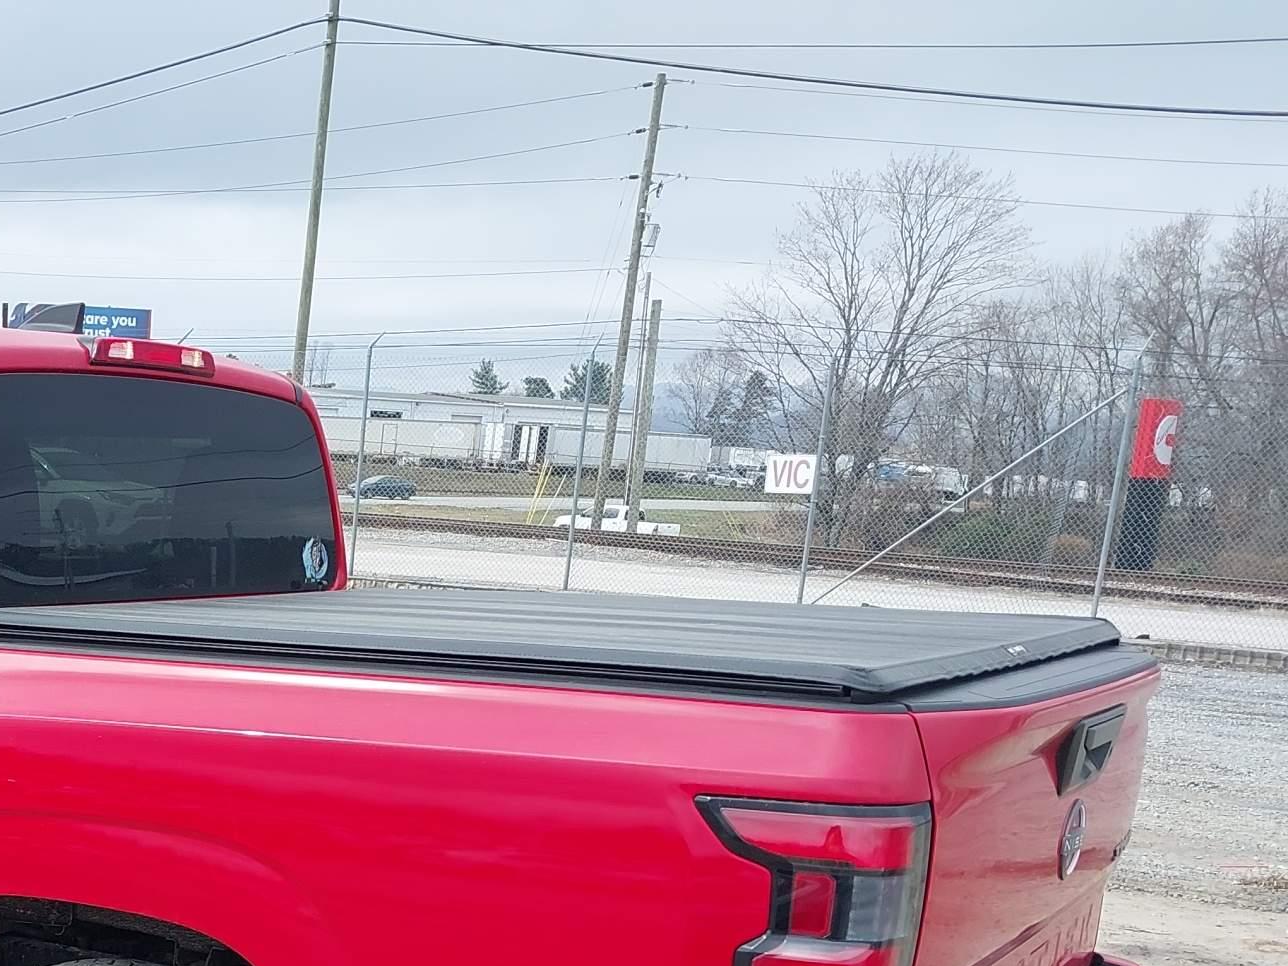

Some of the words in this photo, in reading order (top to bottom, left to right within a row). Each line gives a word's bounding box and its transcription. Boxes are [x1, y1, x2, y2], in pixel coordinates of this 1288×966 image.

[83, 313, 108, 325] are
[111, 315, 137, 329] you
[773, 459, 811, 489] VIC
